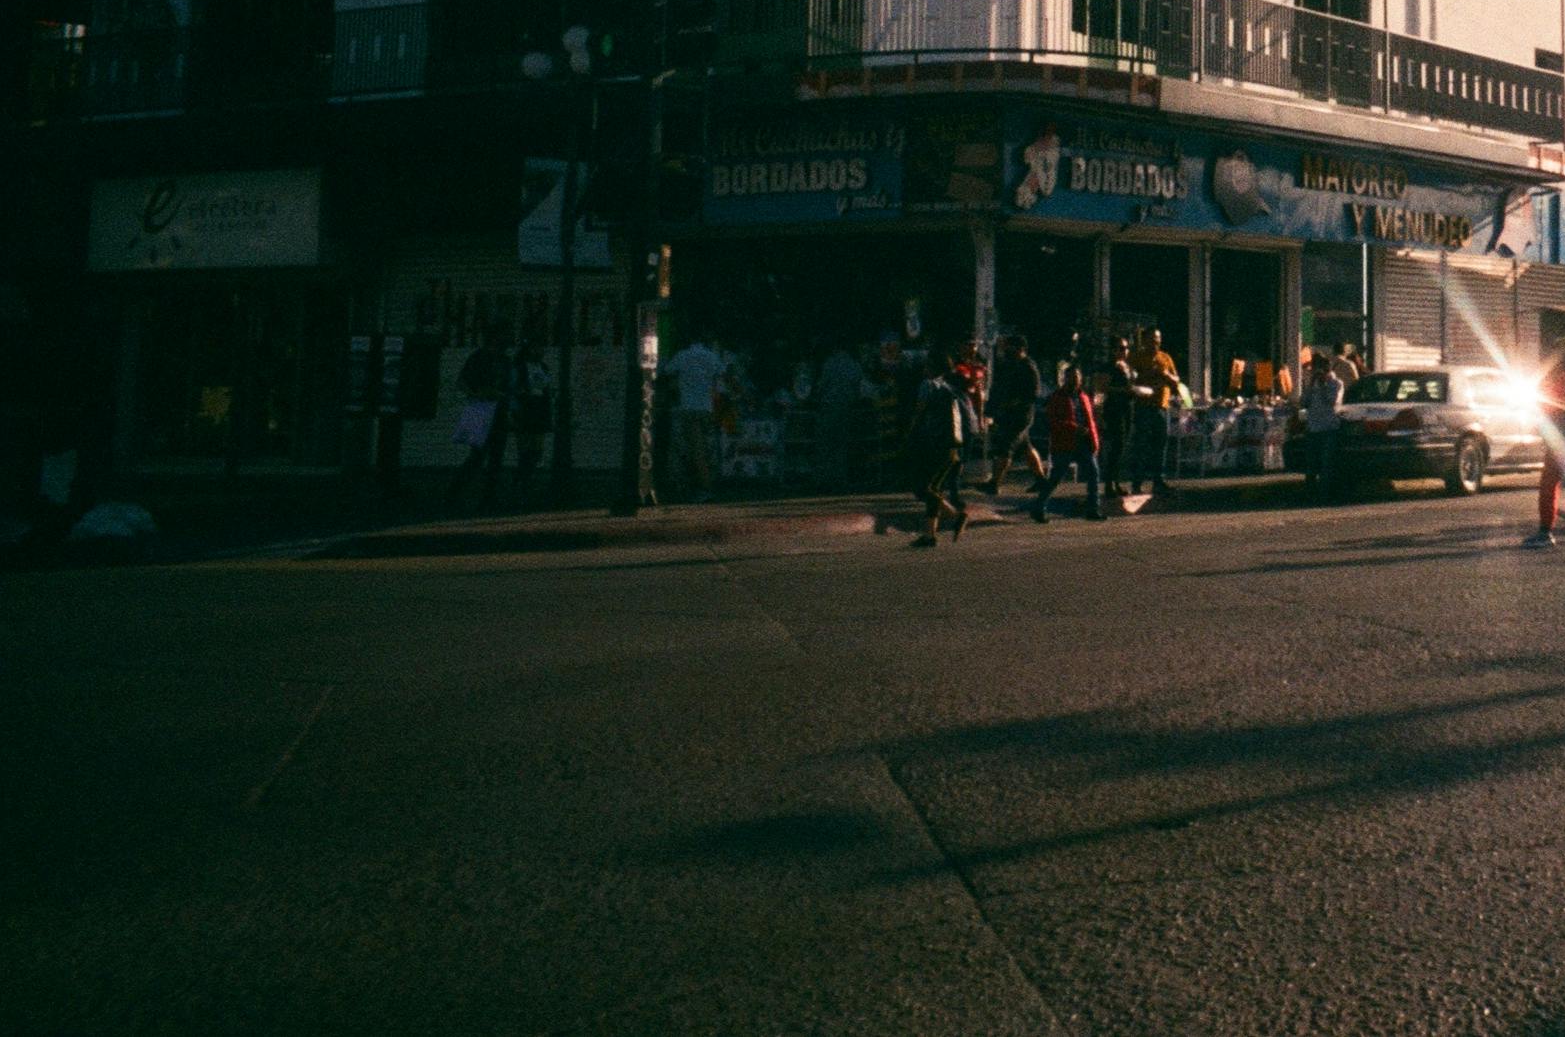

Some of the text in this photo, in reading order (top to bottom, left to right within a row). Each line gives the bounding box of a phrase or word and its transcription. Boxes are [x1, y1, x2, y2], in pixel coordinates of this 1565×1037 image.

[712, 158, 867, 198] BORDADOS
[1070, 156, 1188, 200] BORDADOS
[1302, 152, 1408, 199] MAYOREO
[1351, 203, 1472, 246] Y MENUDEO
